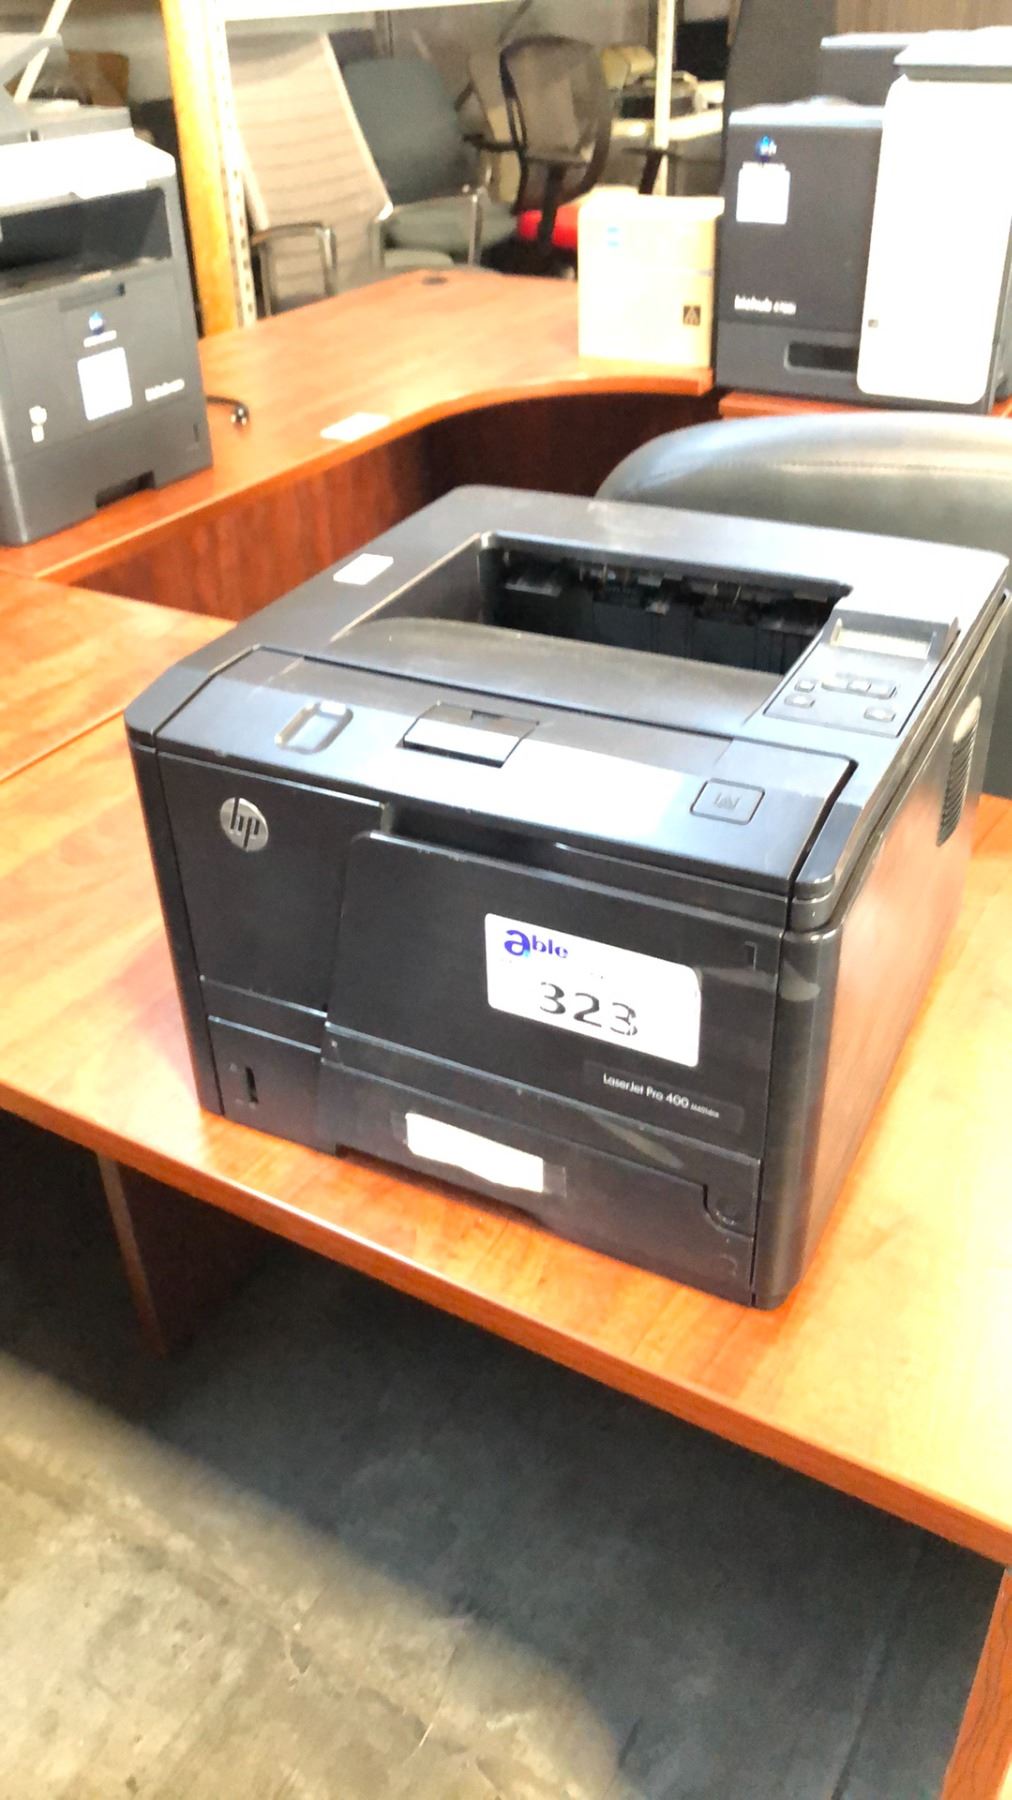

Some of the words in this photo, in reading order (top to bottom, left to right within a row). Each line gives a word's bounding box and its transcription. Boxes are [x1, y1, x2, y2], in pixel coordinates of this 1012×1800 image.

[539, 981, 639, 1037] 323
[602, 1072, 644, 1096] LaserJet
[646, 1085, 664, 1102] Pro
[665, 1092, 690, 1110] 400
